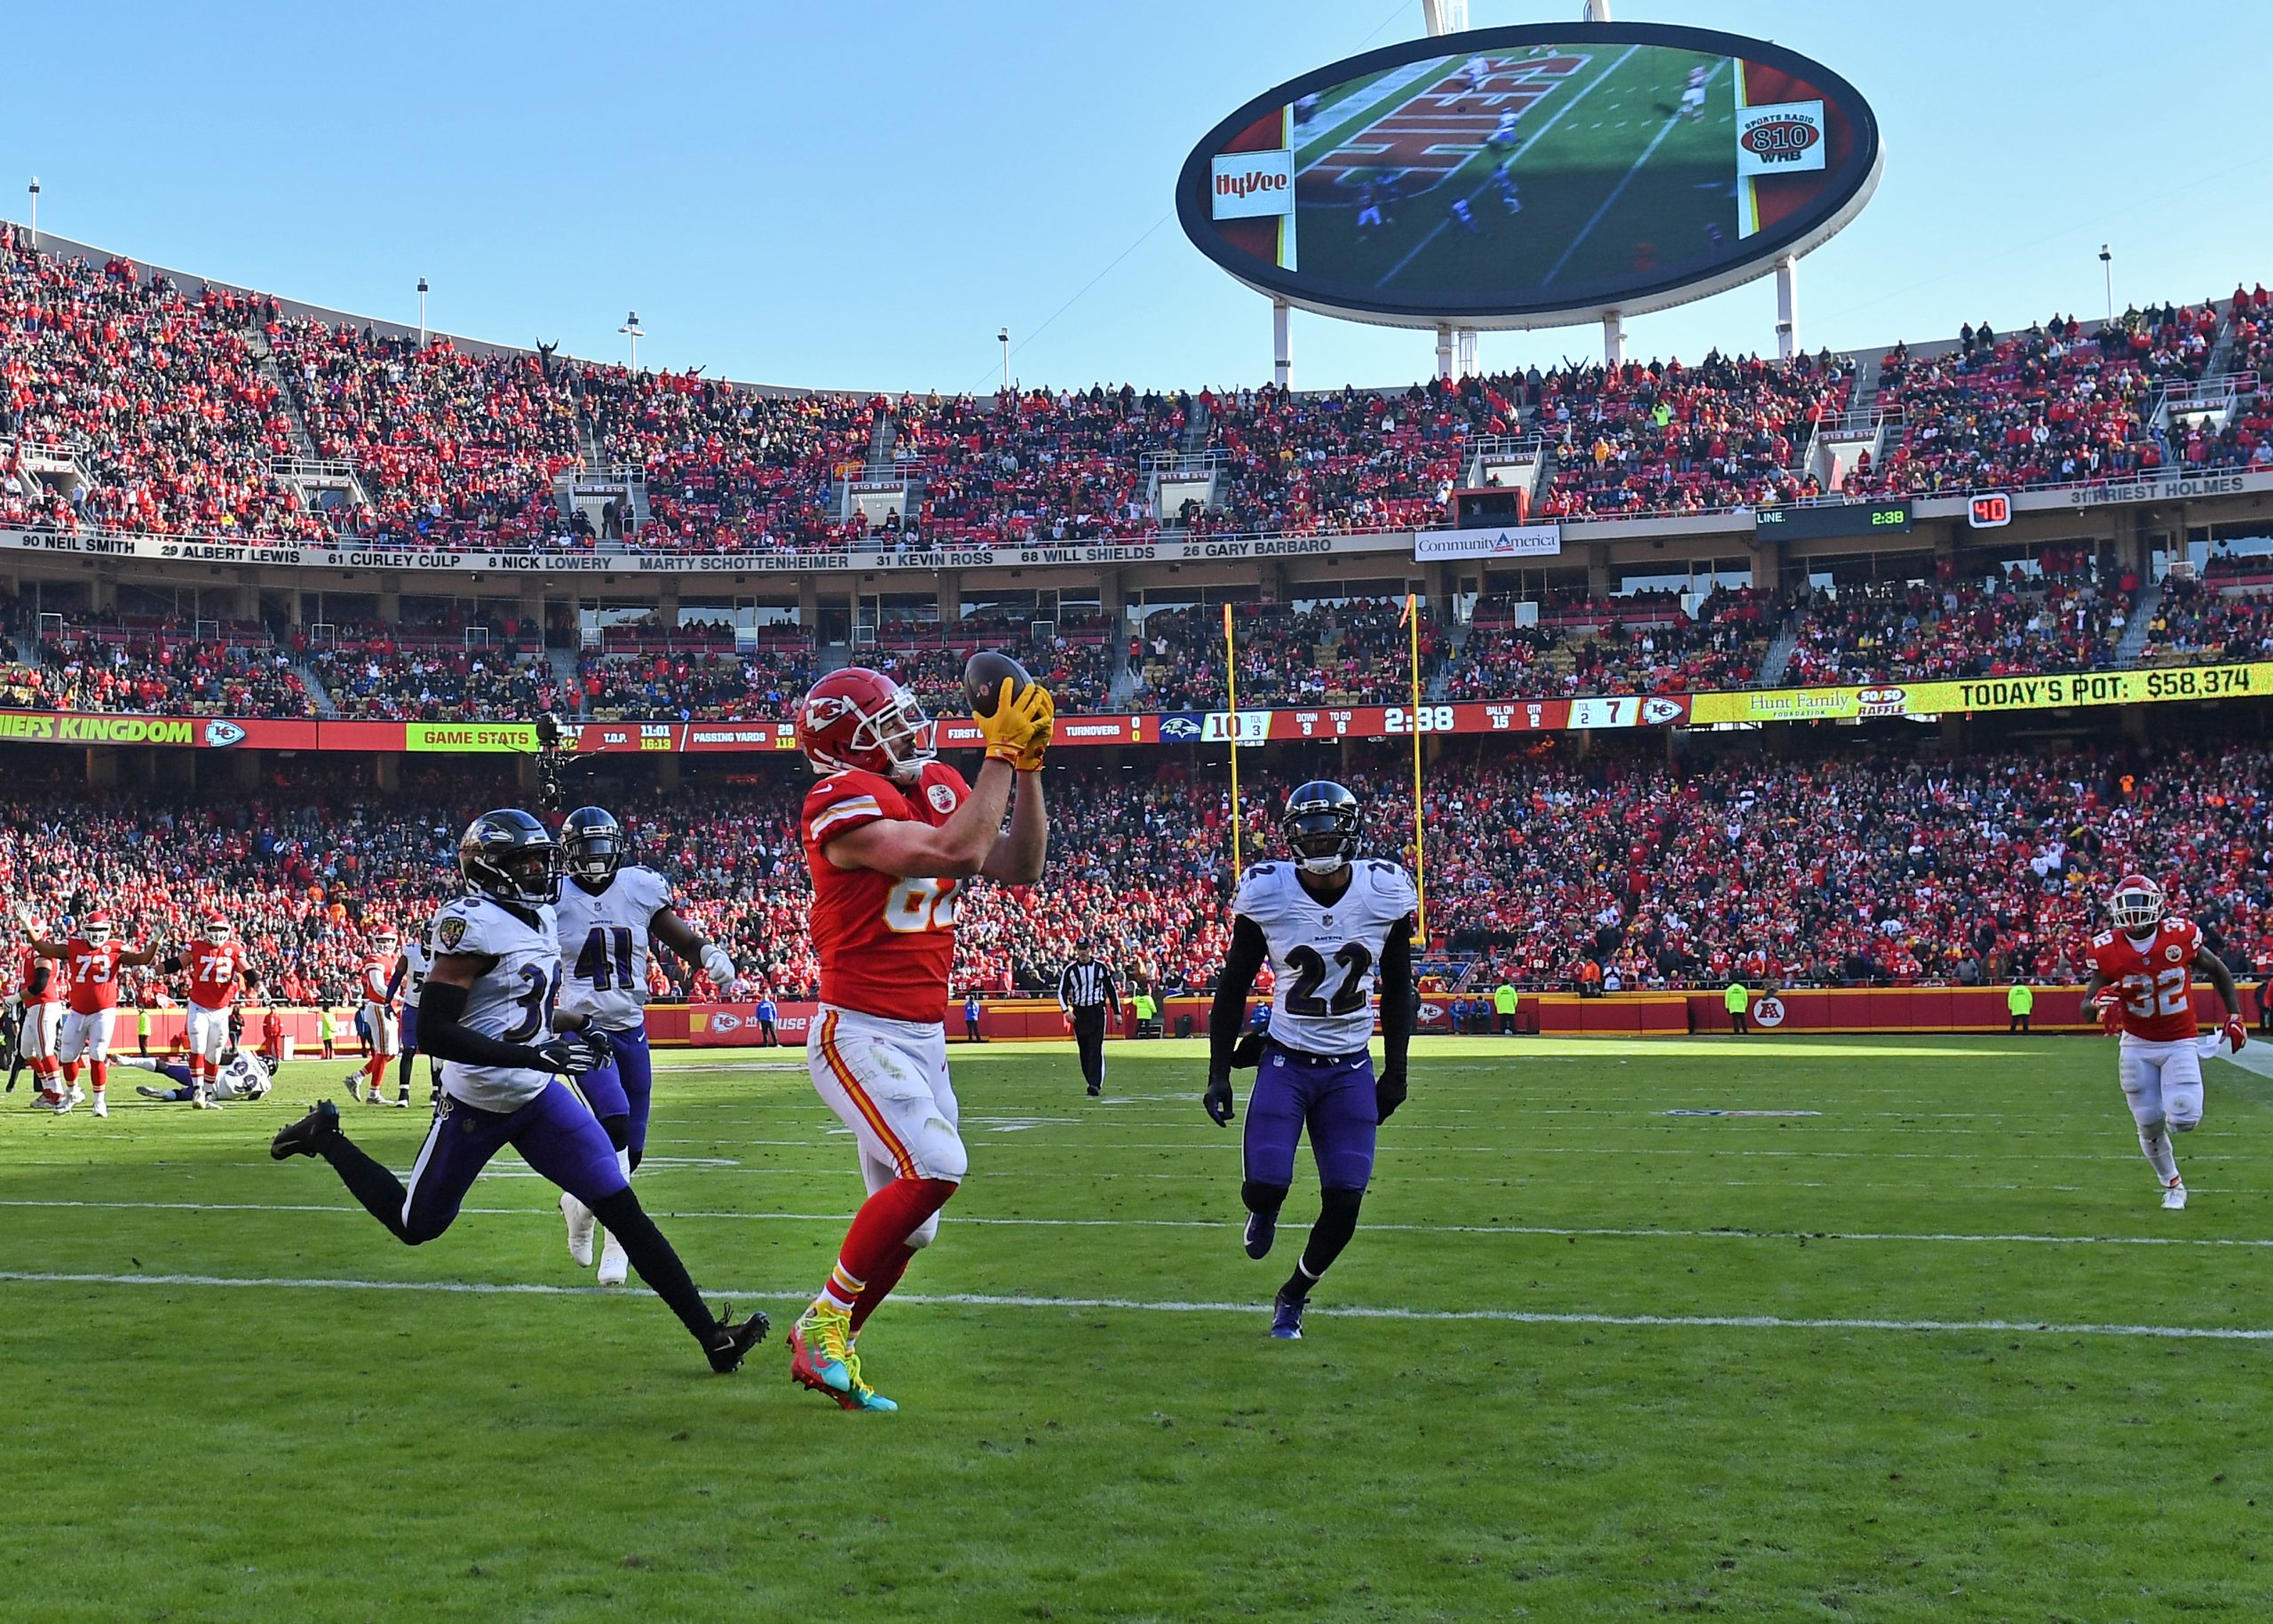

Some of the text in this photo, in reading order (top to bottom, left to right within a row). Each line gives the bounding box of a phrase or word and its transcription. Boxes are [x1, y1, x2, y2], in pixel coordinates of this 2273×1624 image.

[1745, 114, 1814, 130] SPORTS RADIO
[1753, 125, 1809, 151] 810
[1760, 150, 1802, 163] WHB
[2166, 477, 2244, 497] HOLMES
[1974, 499, 2006, 521] 40
[1872, 511, 1905, 525] 2:38
[23, 535, 135, 554] 90 NEIL SMITH
[1183, 538, 1332, 558] 26 GARY BARBARO
[161, 544, 300, 563] 29 ALBERT LEWIS
[328, 552, 460, 568] 61 CURLEY CULP
[876, 551, 994, 566] 31 KEVIN ROSS
[1021, 545, 1155, 563] 68 WILL SHIELDS
[488, 555, 612, 570] 8 NICK LOWERY
[640, 555, 849, 570] MARTY SCHOTTENHEIMER
[1960, 668, 2250, 706] TODAY'S POT: $58,374
[1750, 691, 1850, 710] Hunt Family
[1859, 689, 1902, 701] 50/50
[1526, 704, 1542, 714] QTR
[1605, 701, 1621, 724] 7
[1773, 709, 1826, 718] FOUNDATION
[1857, 704, 1905, 717] RAFFLE
[1131, 716, 1140, 729] 0
[1295, 712, 1319, 723] DOWN
[1384, 706, 1454, 733] 2:38
[1492, 715, 1509, 729] 15
[1530, 714, 1540, 728] 2
[1580, 712, 1589, 725] 2
[59, 717, 193, 743] KINGDOM
[640, 725, 670, 737] 11:01
[777, 724, 795, 736] 29
[1065, 725, 1120, 737] TURNOVERS
[1211, 714, 1241, 738] 10
[1252, 725, 1261, 736] 3
[1302, 722, 1312, 736] 3
[1336, 720, 1347, 734] 6
[424, 731, 529, 745] GAME STATS
[603, 733, 628, 743] T.O.P.
[693, 732, 767, 743] PASSING YARDS
[947, 728, 976, 740] FIRST
[1131, 730, 1140, 742] 0
[640, 738, 671, 750] 16:13
[774, 737, 796, 749] 118
[574, 927, 635, 992] 41
[75, 954, 111, 984] 73
[199, 955, 234, 984] 72
[1285, 941, 1373, 1018] 22
[2121, 966, 2189, 1018] 32
